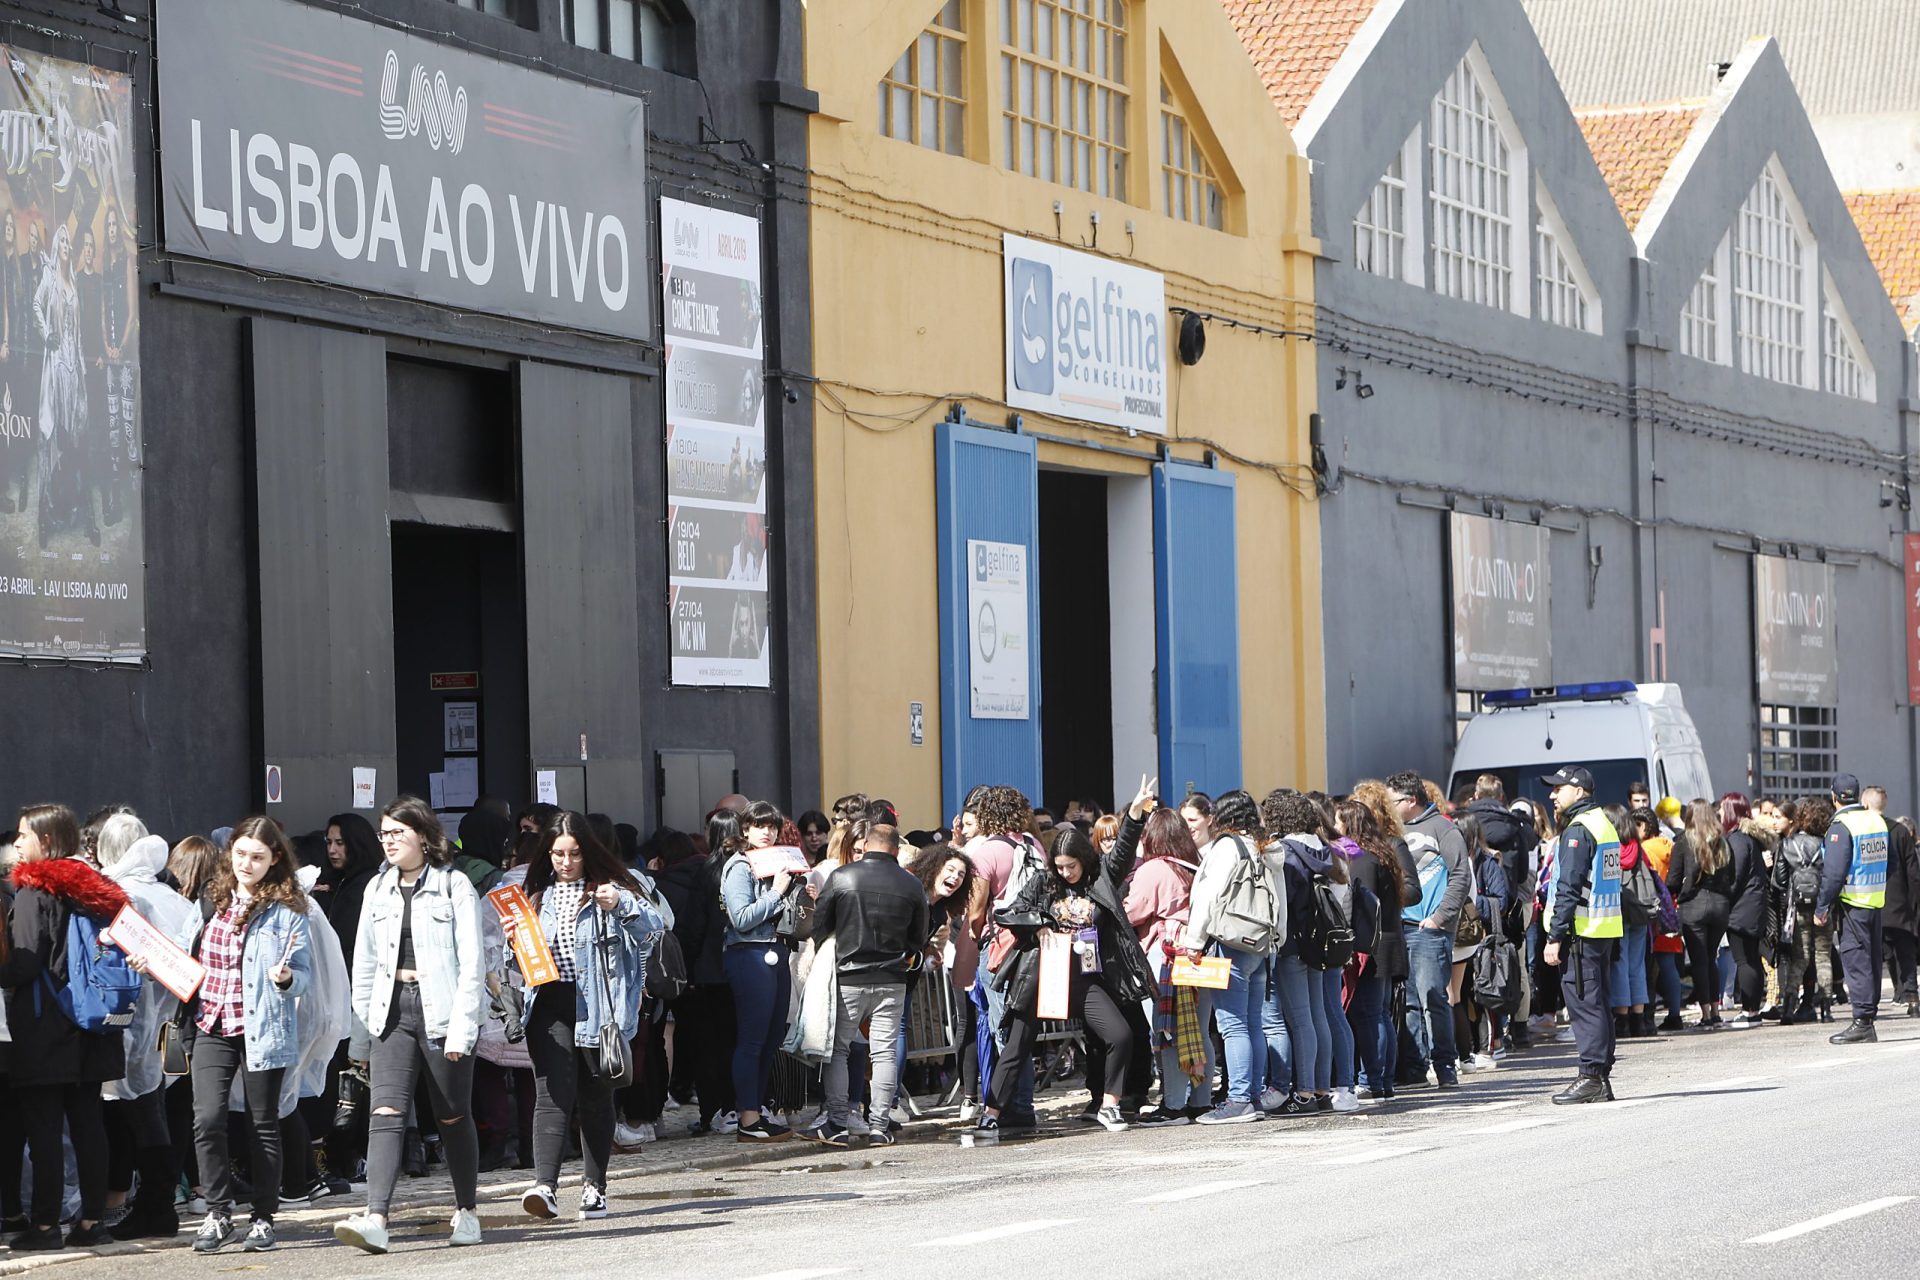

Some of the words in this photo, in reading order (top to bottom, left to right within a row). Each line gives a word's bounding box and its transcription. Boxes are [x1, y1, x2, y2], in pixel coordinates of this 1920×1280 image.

[190, 119, 408, 269] LISBOA
[420, 176, 494, 286] AO
[509, 194, 629, 312] VIVO
[717, 233, 733, 259] ABRIL
[672, 298, 720, 336] COMETHAZINE
[1056, 276, 1161, 377] gelfina
[674, 379, 698, 411] YOUNG
[1074, 364, 1161, 396] CONGELADOS
[676, 439, 698, 455] 18/04
[677, 520, 701, 540] 19/04
[678, 541, 696, 571] BELO
[988, 546, 1020, 576] gelfina
[10, 577, 36, 595] ABRIL
[44, 580, 61, 597] LAV
[63, 582, 92, 599] LISBOA
[94, 583, 106, 599] AO
[108, 583, 128, 599] VIVO
[679, 600, 703, 618] 27/04
[679, 620, 692, 650] MC
[692, 622, 707, 652] WM
[102, 1013, 134, 1025] PUMA
